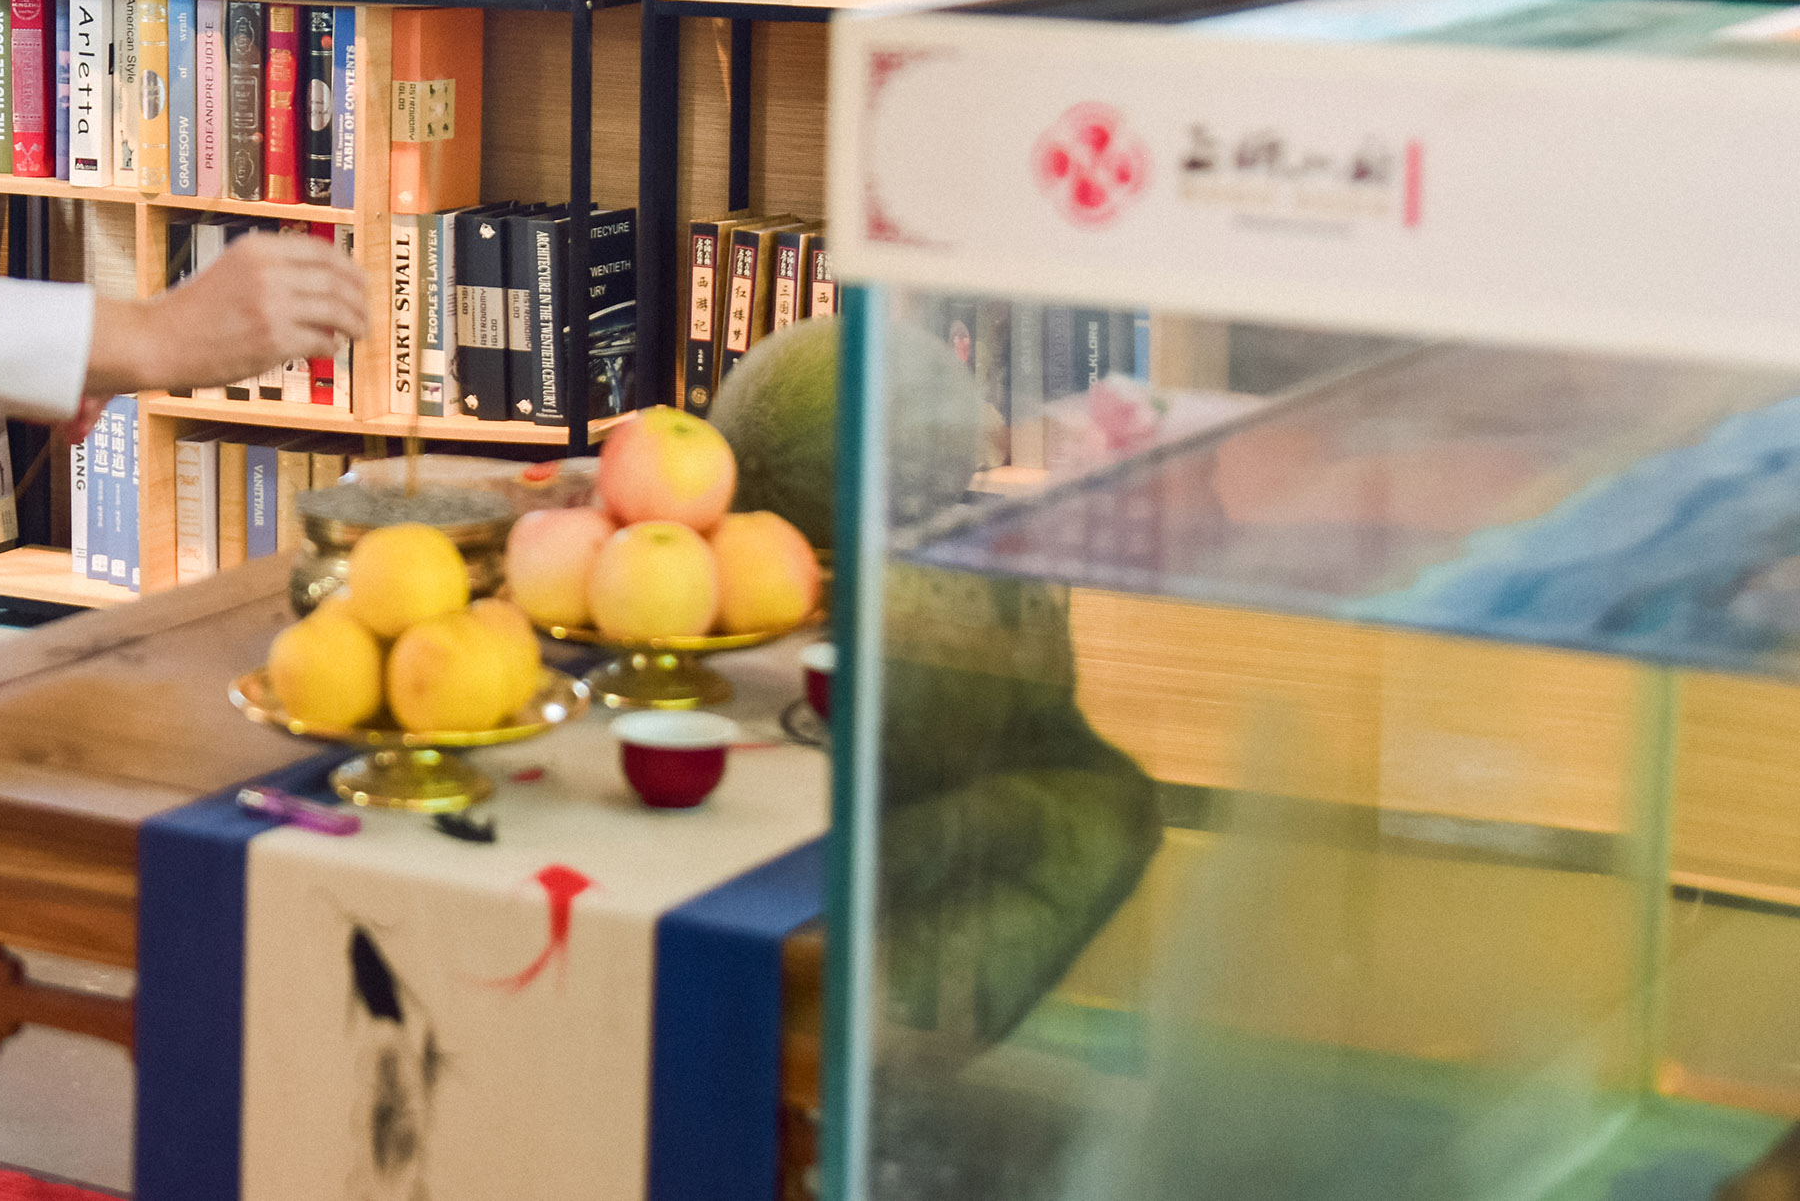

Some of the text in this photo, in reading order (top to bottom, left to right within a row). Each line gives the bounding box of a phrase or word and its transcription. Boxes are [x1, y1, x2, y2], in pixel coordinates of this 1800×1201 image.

[78, 5, 95, 134] Arletta
[126, 55, 138, 84] Style
[177, 12, 190, 188] GRAPESOFW of wrath
[205, 21, 214, 170] PRIDEANDPREJUDICE
[343, 45, 356, 171] TABLE OF CONTENTS
[427, 229, 438, 345] PEOPLE'S LAWYER
[589, 260, 632, 278] WENTIETH
[589, 284, 607, 298] URY
[394, 233, 411, 394] START SMALL
[539, 304, 553, 321] THE
[540, 321, 555, 368] TWENTIETH
[1088, 321, 1099, 388] OLKLORE
[541, 369, 556, 407] CENTURY
[253, 464, 265, 527] VANITYFAIR
